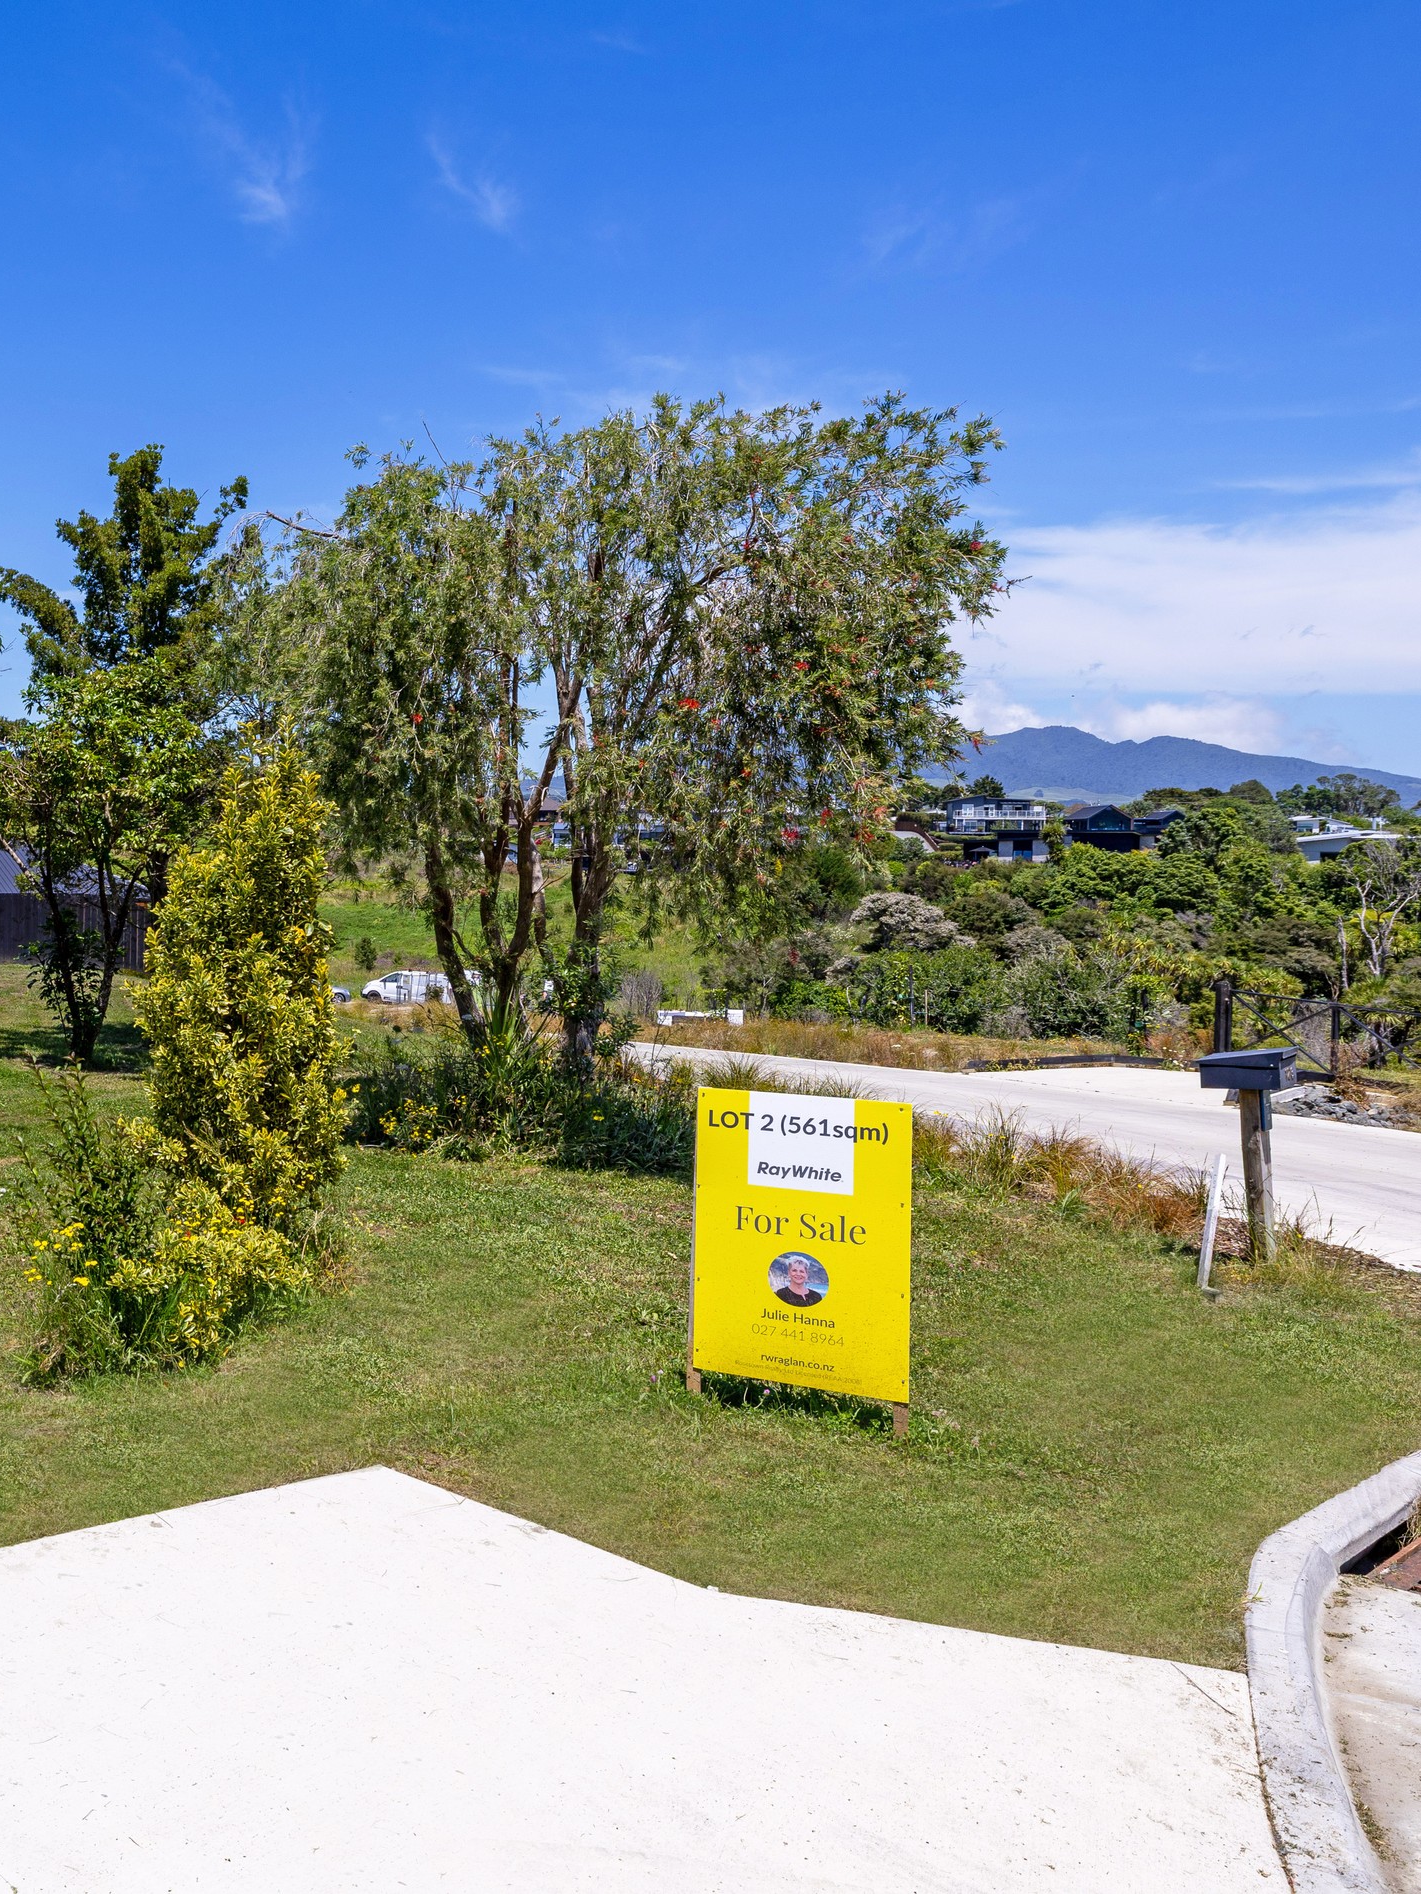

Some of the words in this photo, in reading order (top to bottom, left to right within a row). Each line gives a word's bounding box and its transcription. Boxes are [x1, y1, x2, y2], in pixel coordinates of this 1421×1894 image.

[708, 1109, 755, 1130] LOT
[760, 1114, 774, 1131] 2
[780, 1114, 889, 1145] (561sqm)
[735, 1205, 789, 1236] For
[799, 1213, 867, 1245] Sale
[761, 1308, 789, 1322] Julie
[793, 1312, 835, 1329] Hanna
[751, 1323, 776, 1336] 027
[780, 1328, 805, 1341] 441
[810, 1332, 844, 1347] 8964
[760, 1353, 835, 1373] rwraglan.co.nz
